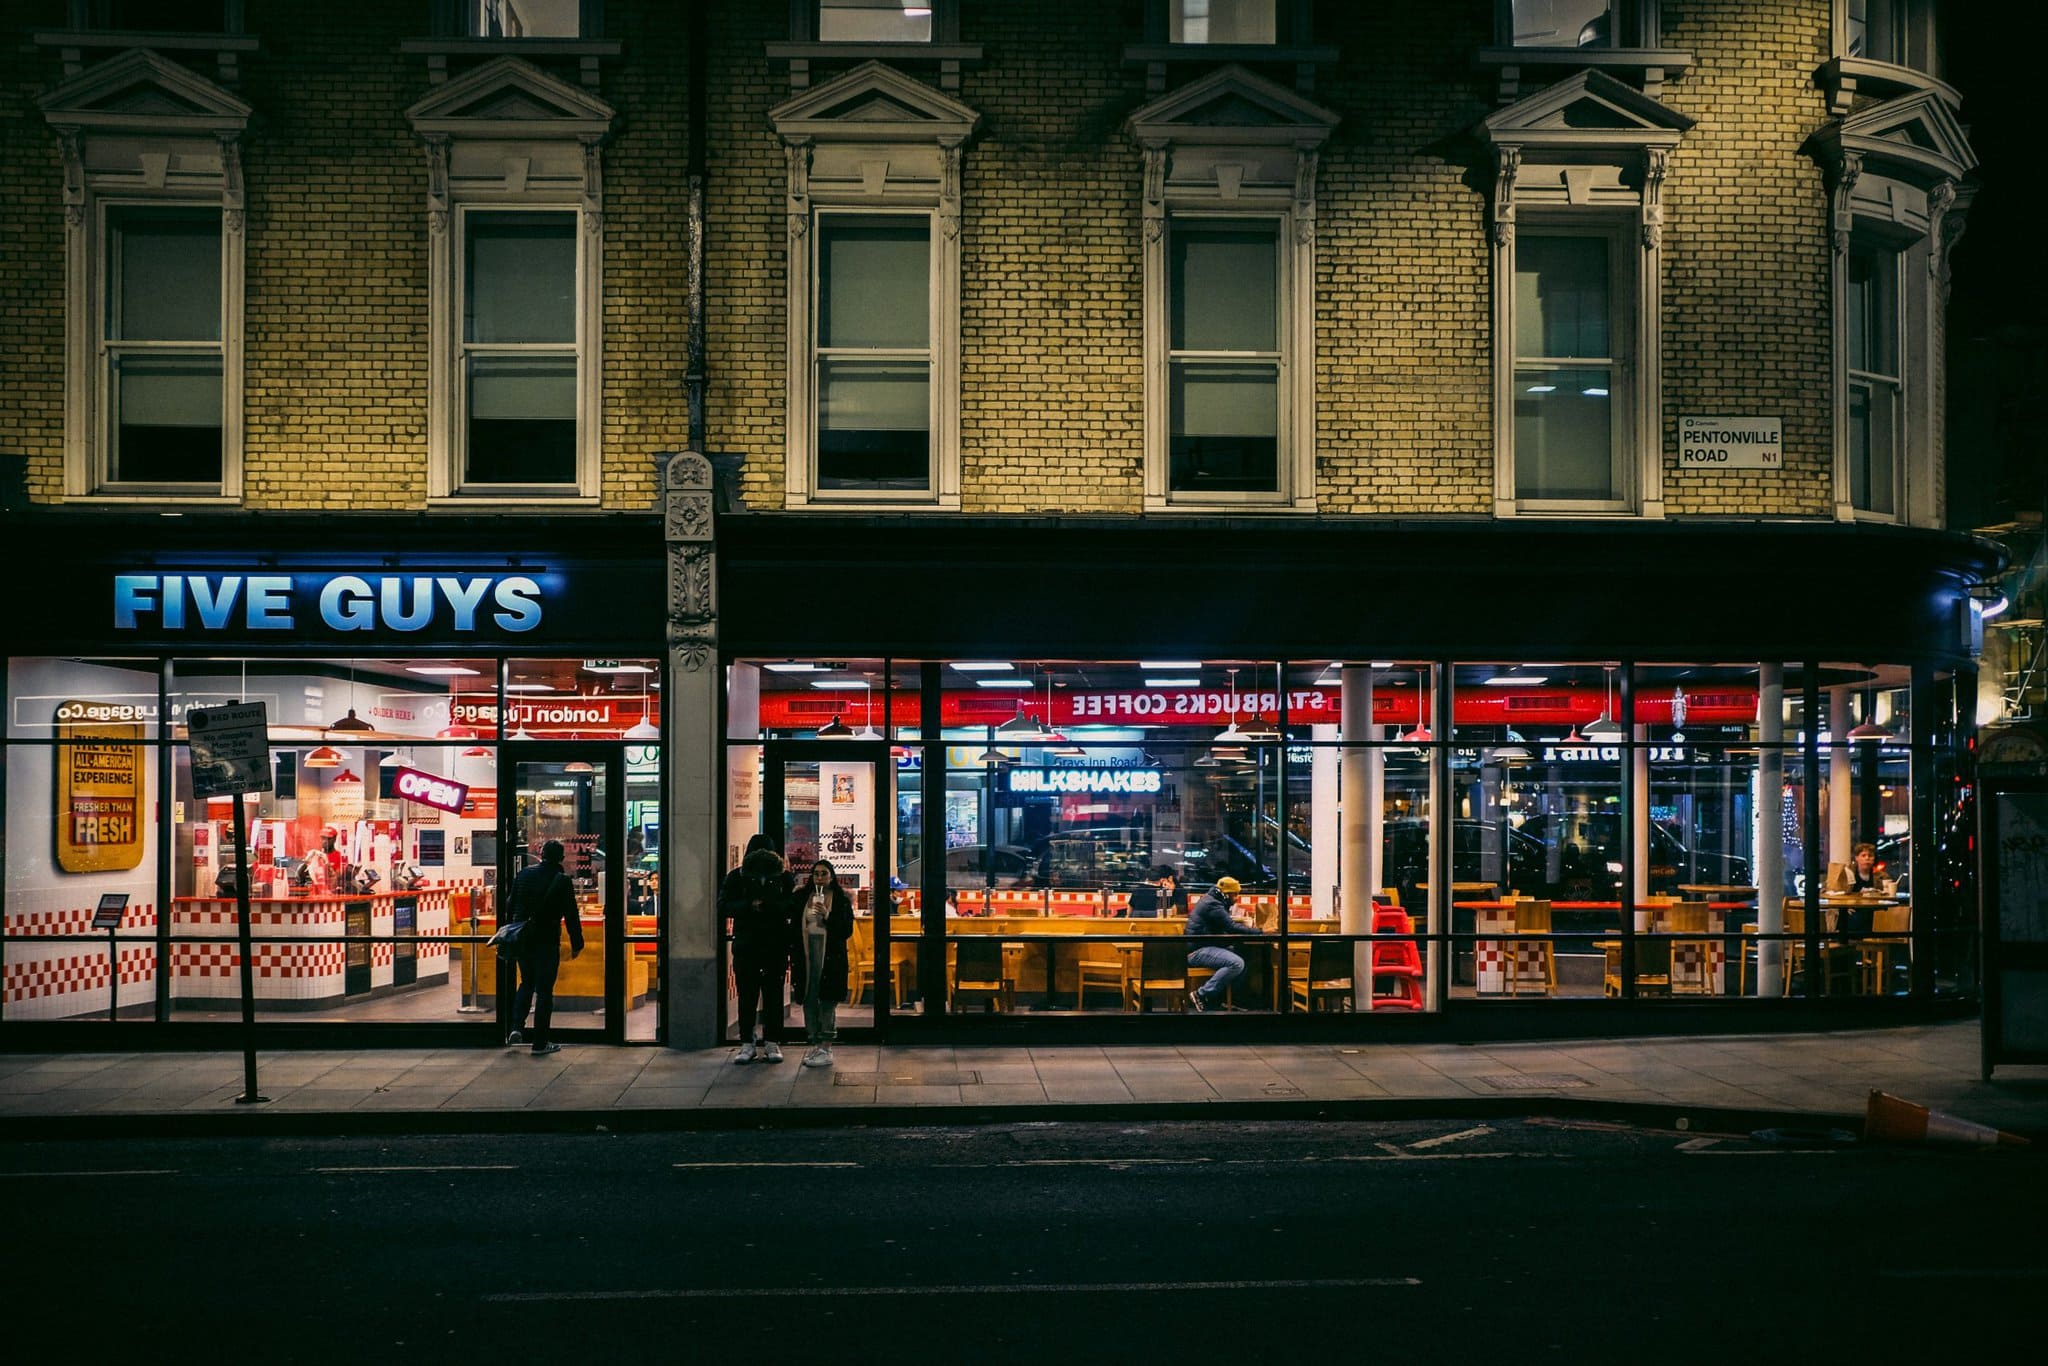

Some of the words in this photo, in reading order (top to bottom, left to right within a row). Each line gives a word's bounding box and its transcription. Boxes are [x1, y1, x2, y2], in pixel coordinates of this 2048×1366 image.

[1683, 431, 1779, 444] PENTONVILLE
[1684, 449, 1728, 462] ROAD
[1762, 453, 1777, 462] N1
[114, 575, 295, 630] FIVE
[319, 575, 543, 632] GUYS
[75, 754, 132, 770] ALL-AMERICAN
[1089, 757, 1106, 767] Inn
[1111, 757, 1138, 767] Road
[74, 772, 132, 784] EXPERIENCE
[1009, 770, 1161, 792] MILKSHAKES
[399, 773, 460, 807] OPEN
[74, 802, 109, 813] FRESHER
[112, 803, 132, 812] THAN
[75, 816, 131, 843] FRESH
